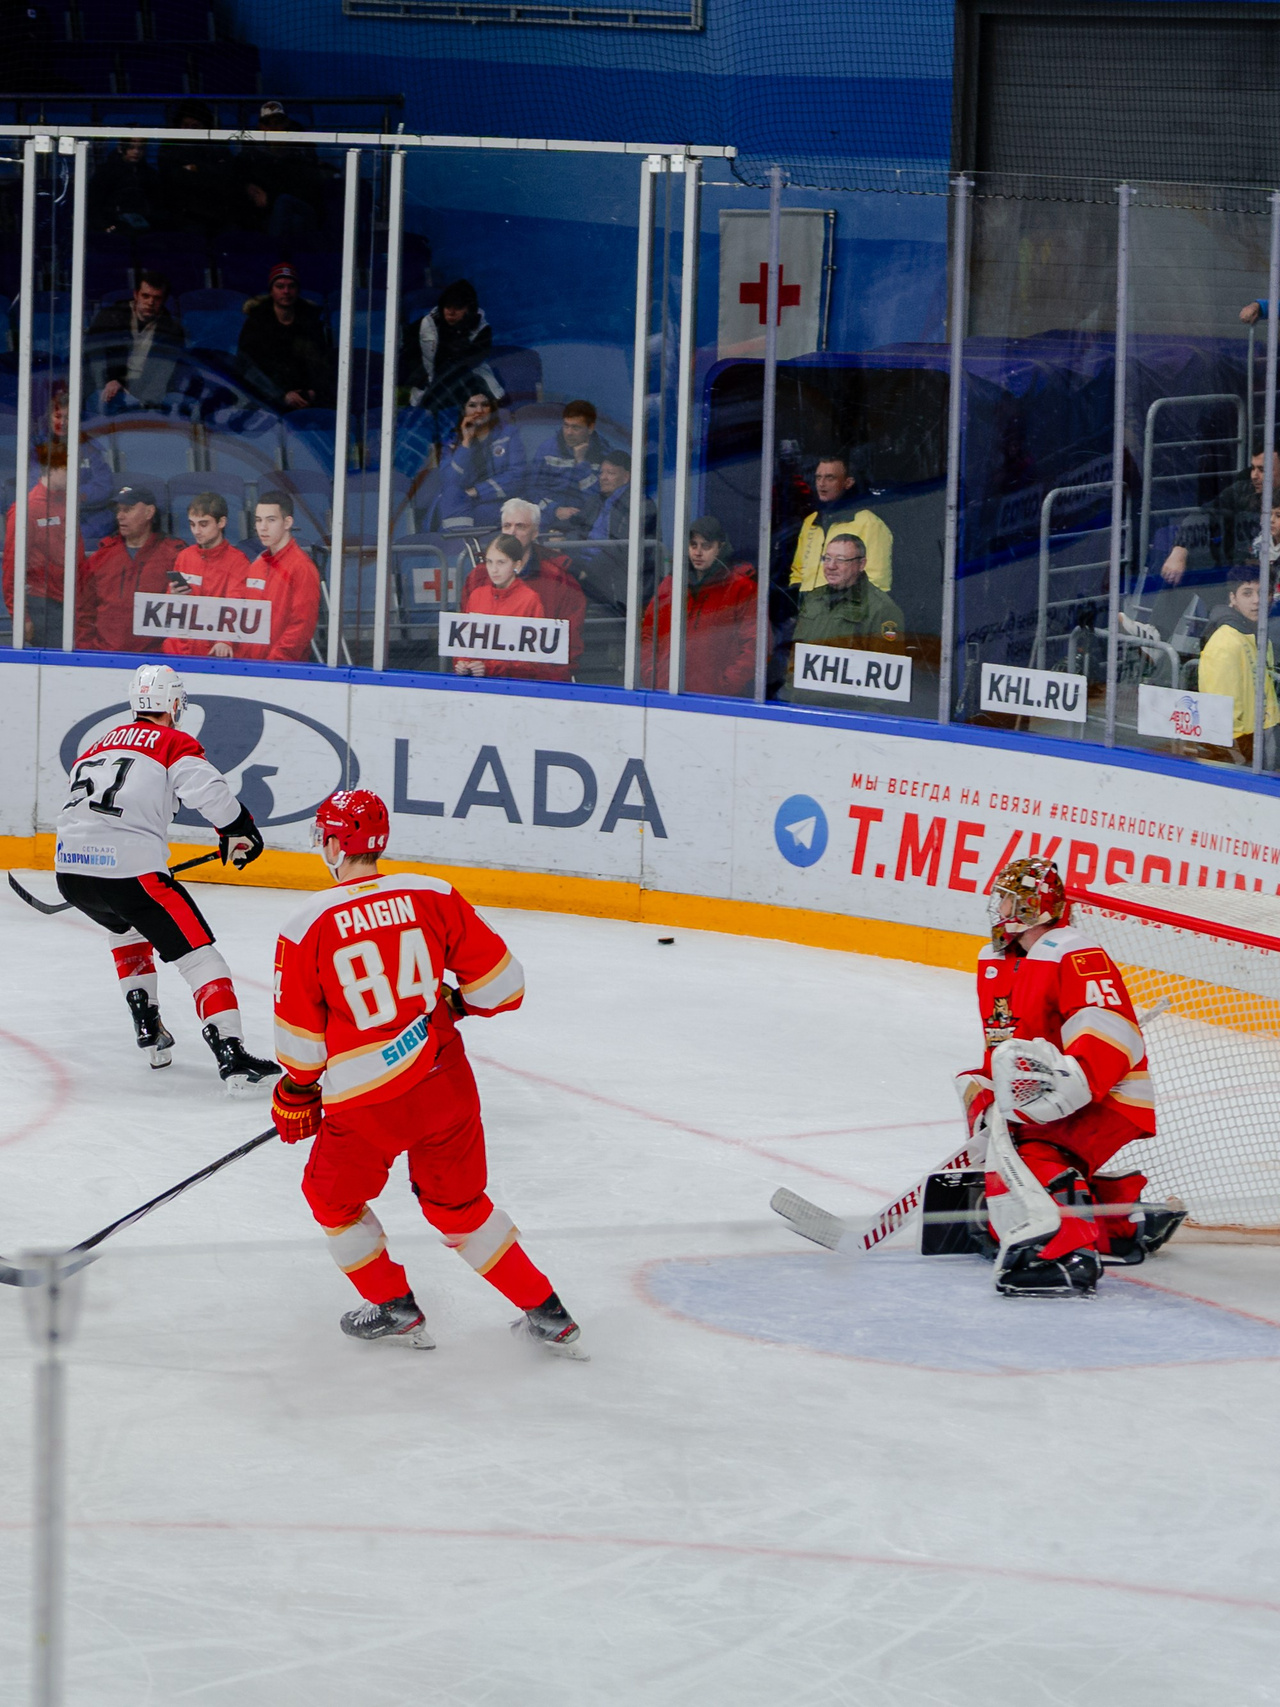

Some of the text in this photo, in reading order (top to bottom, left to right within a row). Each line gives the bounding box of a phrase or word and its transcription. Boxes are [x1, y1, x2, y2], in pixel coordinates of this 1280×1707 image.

[142, 600, 263, 635] KHL.RU
[448, 620, 561, 654] KHL.RU
[801, 652, 904, 691] KHL.RU
[138, 697, 152, 710] 51
[988, 672, 1080, 712] KHL.RU
[62, 756, 136, 818] 51
[393, 737, 669, 839] LADA
[851, 773, 878, 791] МЫ
[887, 777, 951, 803] ВСЕГДА
[960, 788, 980, 807] НА
[989, 793, 1042, 816] СВЯЗИ
[1050, 803, 1185, 844] #REDSTARHOCKEY
[366, 834, 386, 851] 84
[333, 894, 417, 939] PAIGIN
[332, 927, 439, 1031] 84
[1085, 979, 1122, 1007] 45
[381, 1014, 429, 1067] SIBU
